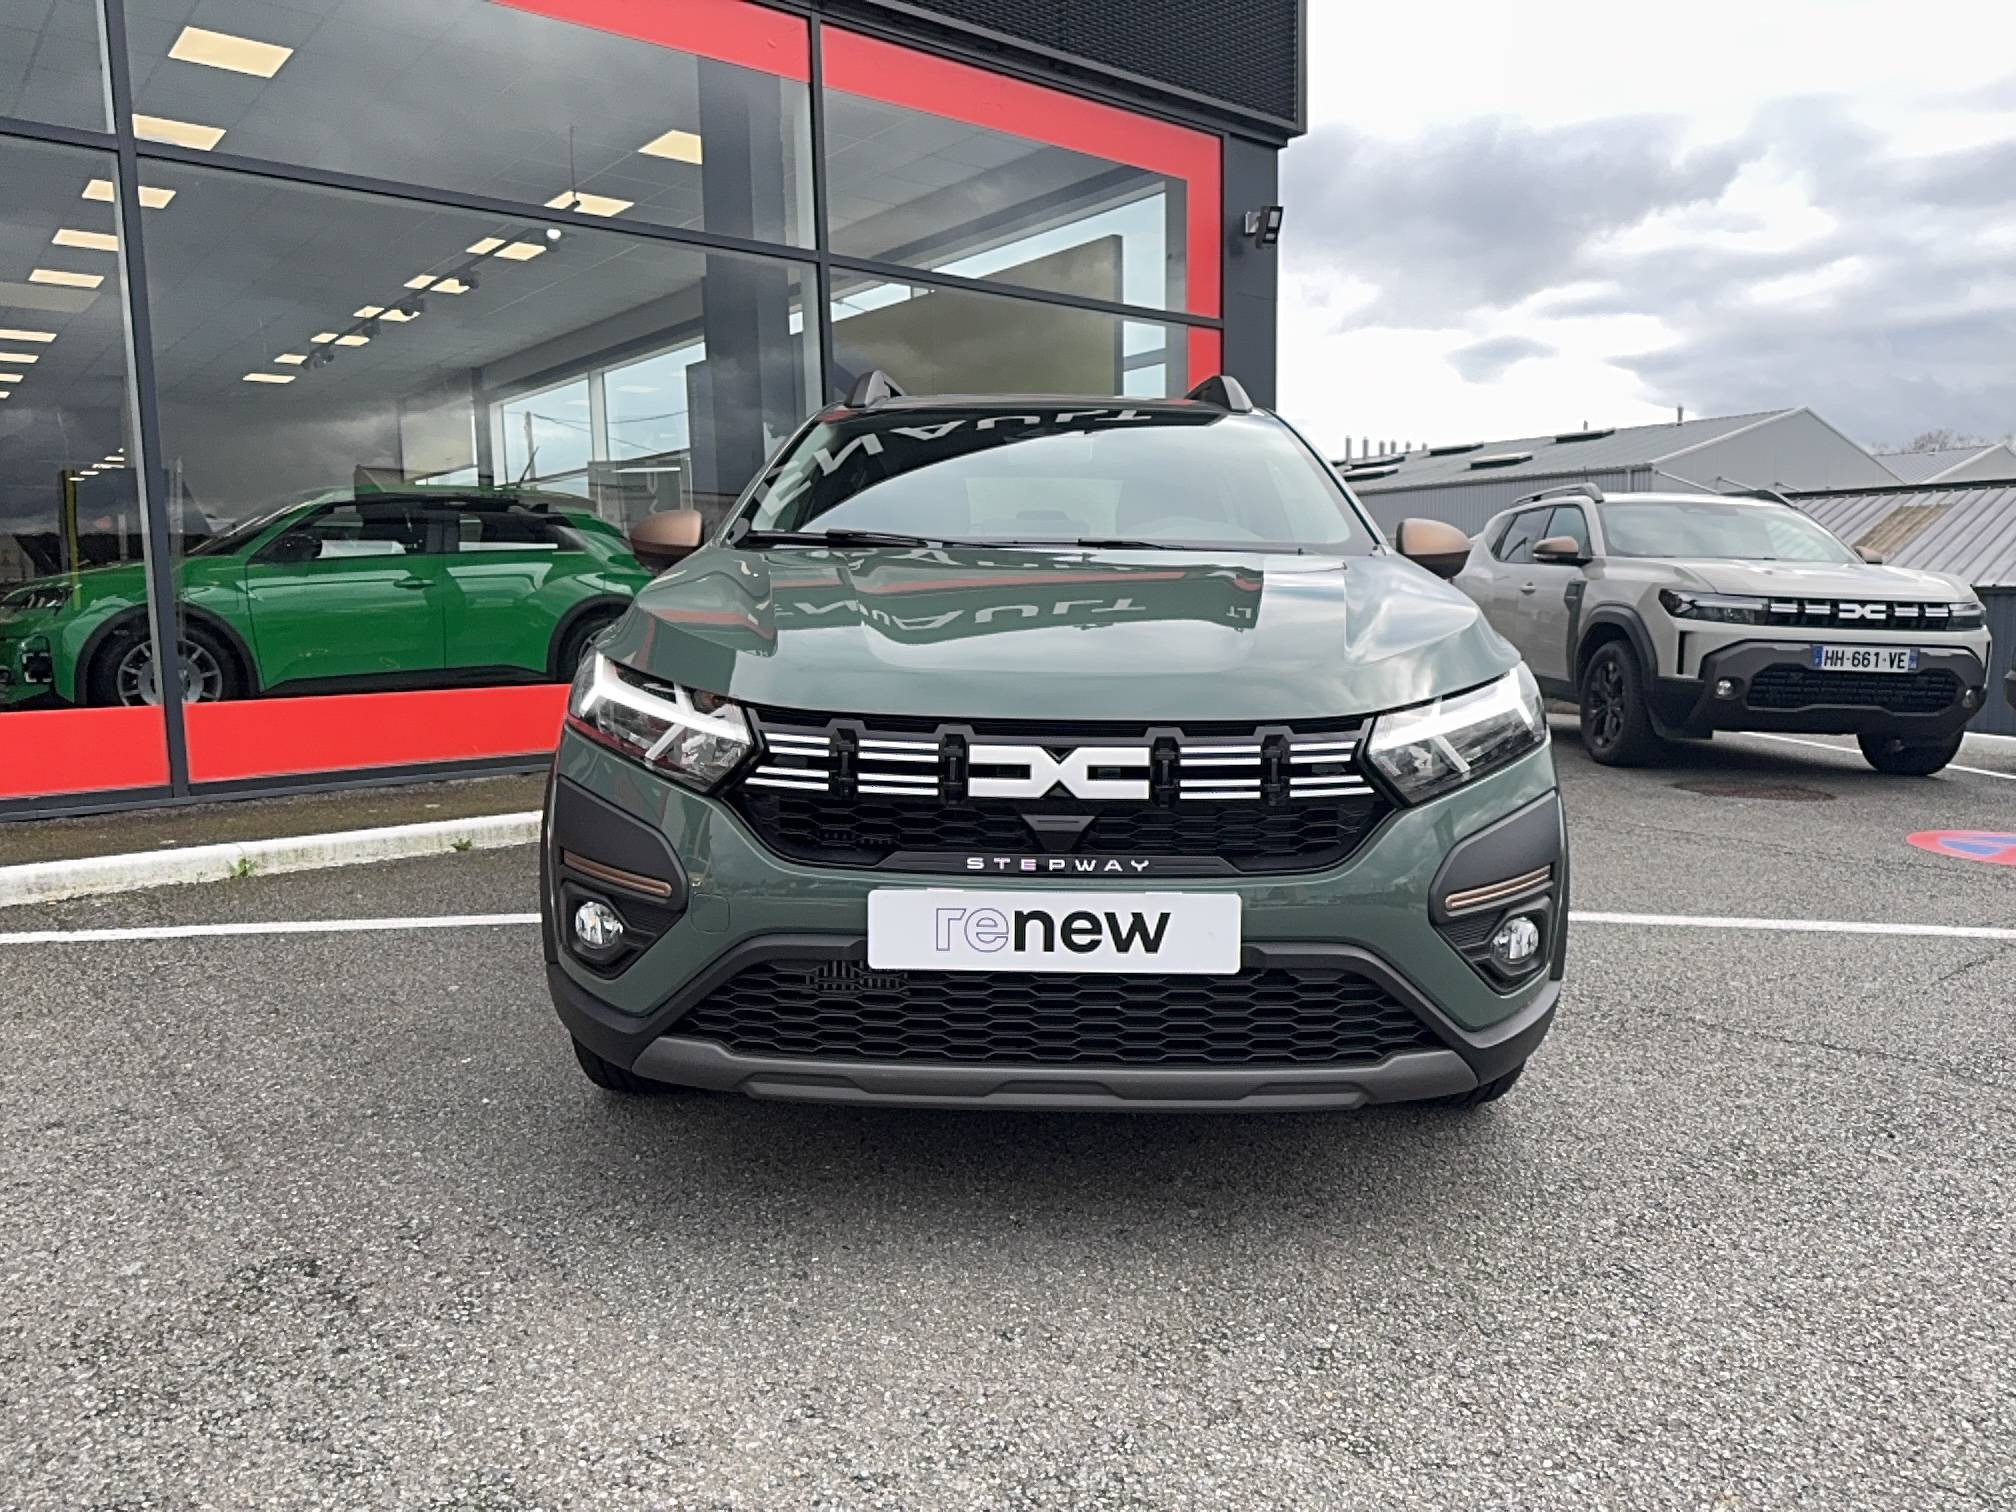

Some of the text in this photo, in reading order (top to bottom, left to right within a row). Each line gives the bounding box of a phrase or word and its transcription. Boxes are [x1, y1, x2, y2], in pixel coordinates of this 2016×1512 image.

[1823, 649, 1907, 669] HH-661-VE
[966, 857, 1150, 872] STEPWAY
[935, 907, 1171, 954] renew
